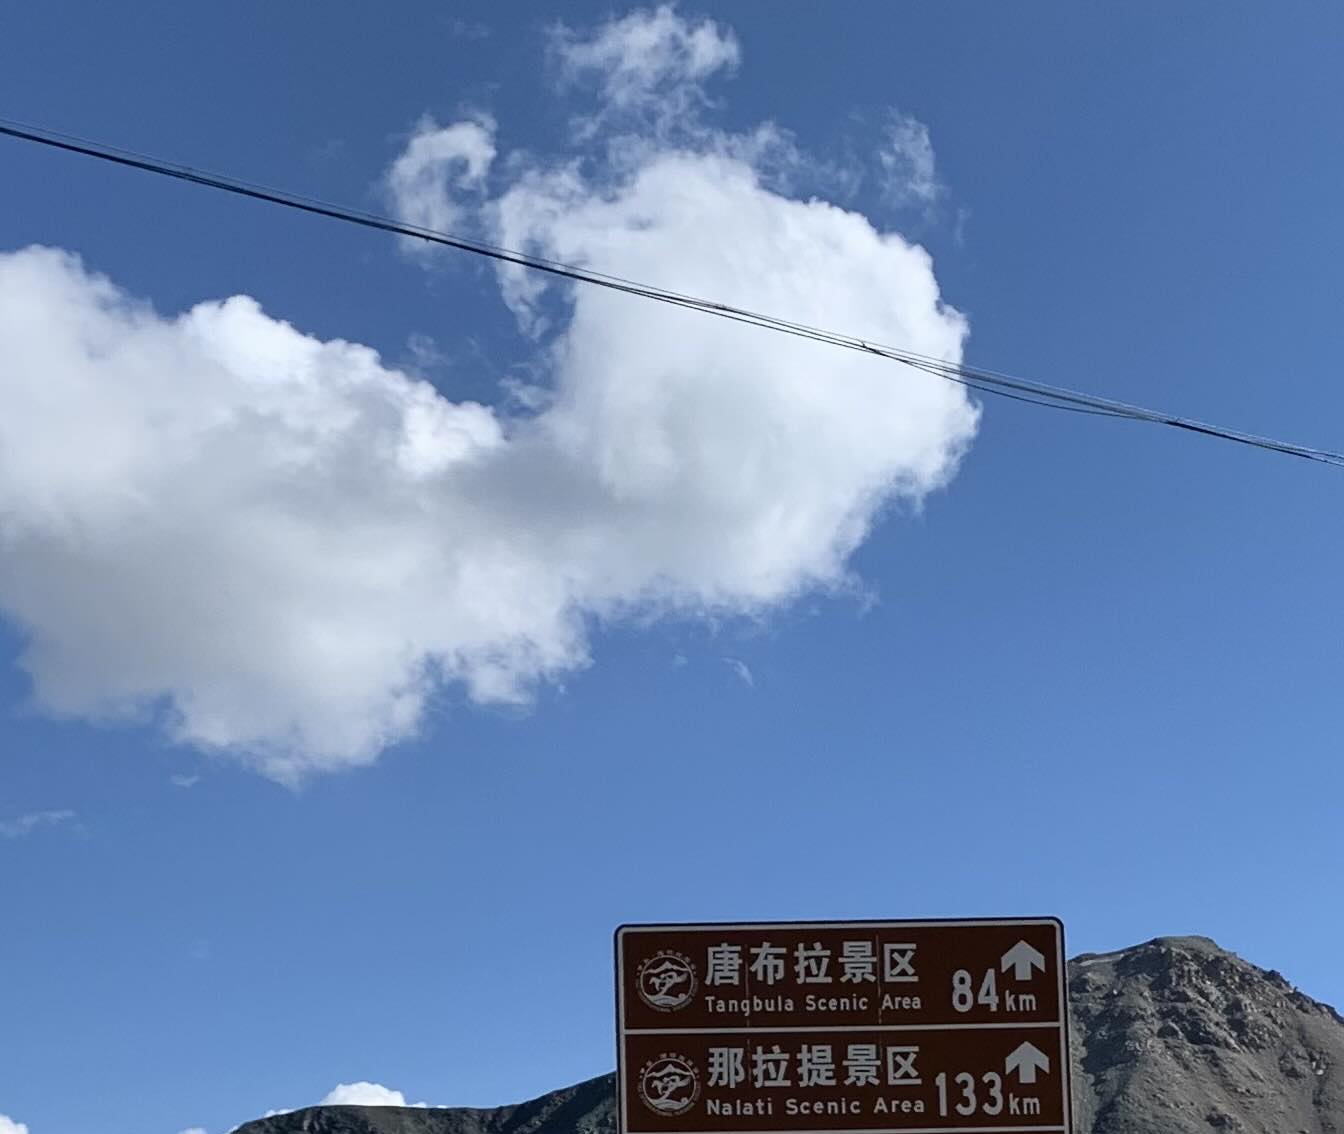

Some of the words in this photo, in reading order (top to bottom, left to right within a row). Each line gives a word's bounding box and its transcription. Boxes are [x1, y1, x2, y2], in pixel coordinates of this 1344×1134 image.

[704, 940, 920, 987] 唐布拉景区
[704, 994, 794, 1017] Tangbula
[805, 994, 869, 1012] Scenic
[881, 993, 922, 1011] Area
[707, 1044, 923, 1089] 那拉提景区
[706, 1097, 774, 1116] Nalati
[785, 1097, 861, 1116] Scenic
[873, 1096, 926, 1115] Area
